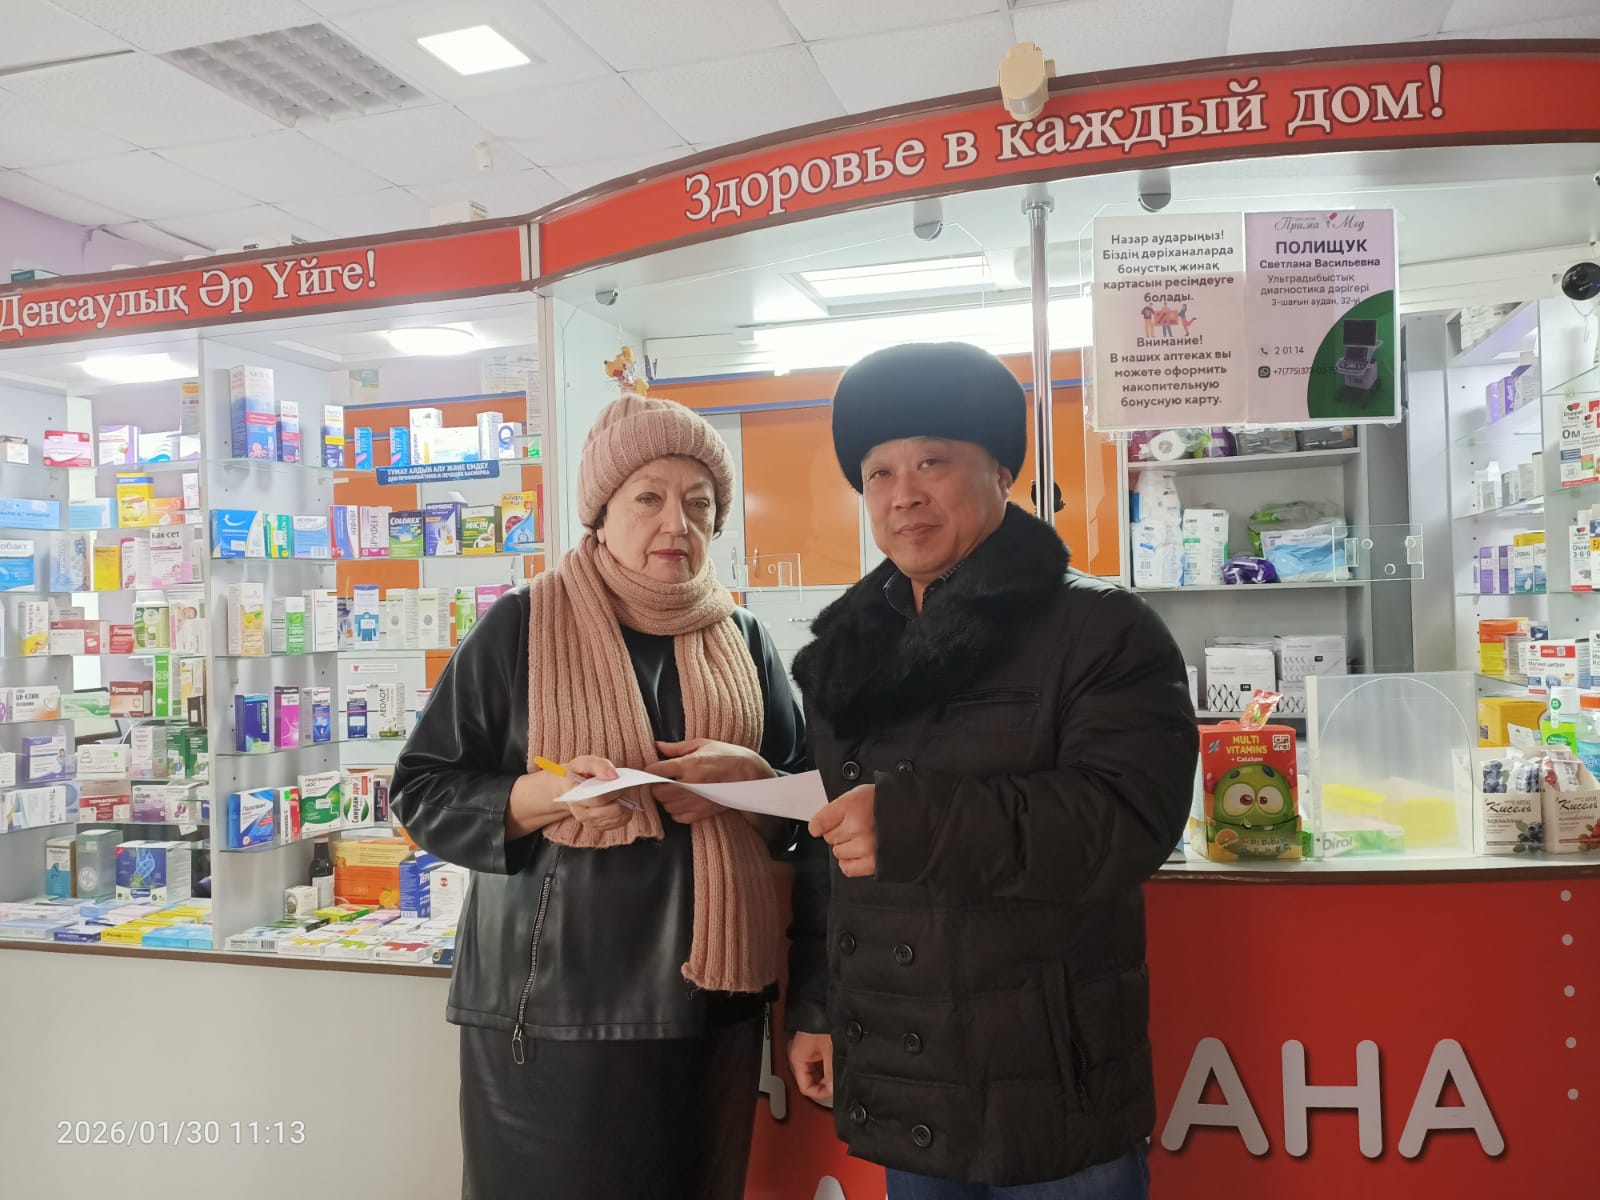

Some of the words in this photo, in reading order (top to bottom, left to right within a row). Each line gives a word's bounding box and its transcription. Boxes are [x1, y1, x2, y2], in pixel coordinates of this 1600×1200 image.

[685, 138, 925, 222] Здоровье
[943, 129, 978, 169] в
[996, 79, 1267, 160] каждый
[1286, 64, 1445, 136] дом!
[1111, 234, 1149, 246] Назар
[1152, 230, 1224, 245] аударыңыз!
[1103, 249, 1139, 260] Біздің
[1142, 246, 1234, 259] дәріханаларда
[1276, 239, 1367, 255] ПОЛИЩУК
[1118, 264, 1177, 275] бонустық
[1180, 262, 1220, 272] жинақ
[1260, 260, 1312, 269] Светлана
[1315, 258, 1380, 267] Васильевна
[1104, 280, 1162, 291] картасын
[1165, 276, 1234, 289] ресімдеуге
[0, 284, 188, 337] Денсаулық
[199, 270, 254, 314] Әр
[263, 250, 376, 299] Үйге!
[1144, 292, 1194, 303] болады.
[1260, 286, 1325, 296] диагностика
[1136, 335, 1203, 347] Внимание!
[1110, 353, 1118, 363] В
[1121, 354, 1160, 363] наших
[1163, 352, 1212, 361] аптеках
[1215, 350, 1231, 359] вы
[1274, 346, 1280, 355] 2
[1295, 346, 1304, 354] 14
[1114, 368, 1161, 377] можете
[1164, 366, 1227, 379] оформить
[1122, 380, 1220, 393] накопительную
[1121, 396, 1182, 408] бонусную
[1185, 395, 1222, 406] карту.
[1232, 735, 1260, 744] MULTI
[1226, 745, 1268, 754] VITAMINS
[1322, 836, 1353, 851] Dirol
